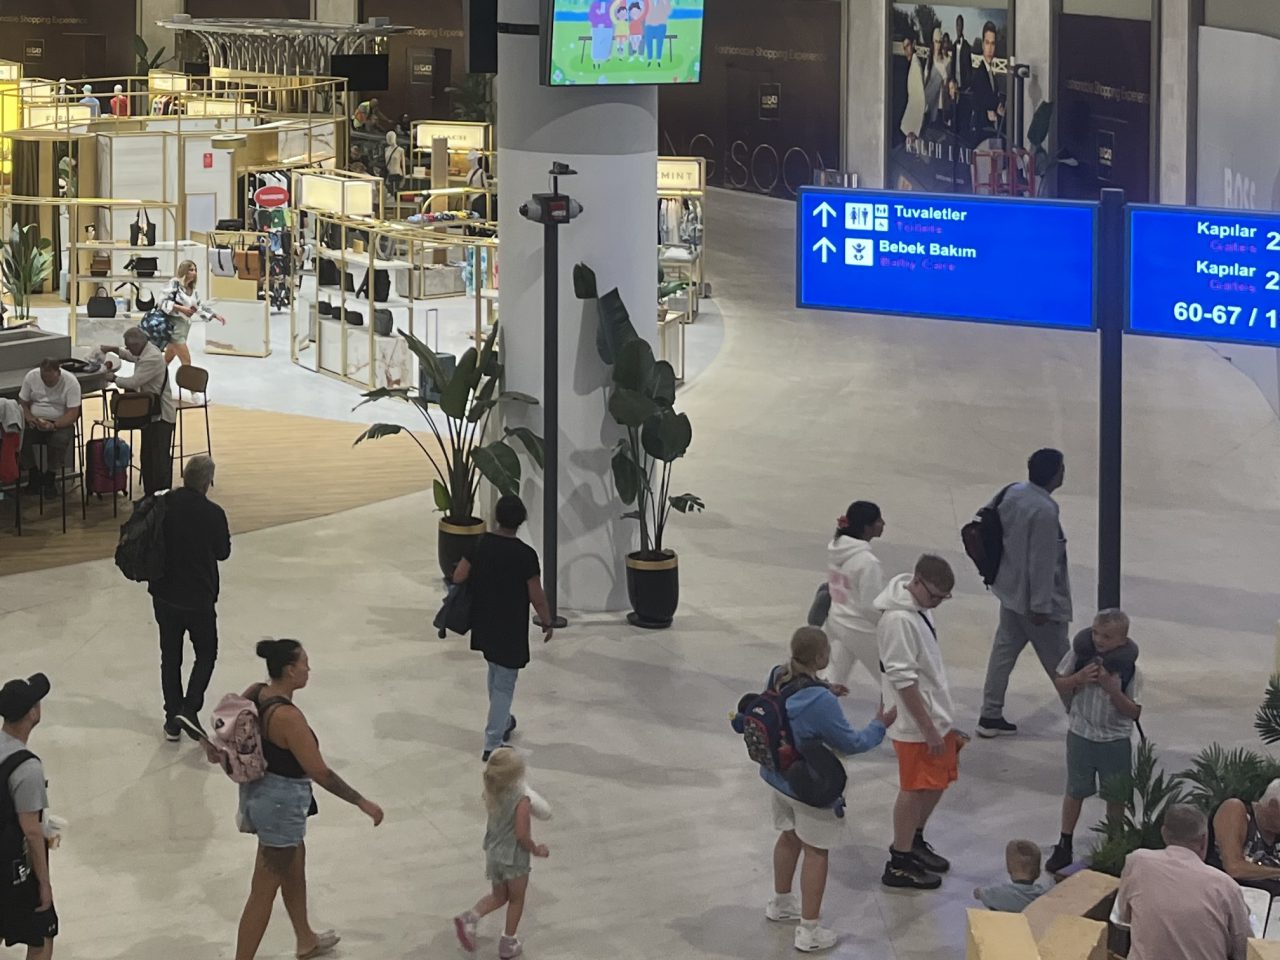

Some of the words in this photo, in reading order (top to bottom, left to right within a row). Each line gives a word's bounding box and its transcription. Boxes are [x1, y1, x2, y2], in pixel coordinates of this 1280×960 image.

[905, 136, 942, 159] RALPH
[948, 145, 972, 165] LAU
[894, 204, 968, 221] Tuvaletler
[1197, 221, 1257, 239] Kapılar
[879, 240, 926, 255] Bebek
[929, 243, 977, 258] Bakım
[1196, 260, 1257, 278] Kapılar
[1209, 279, 1257, 294] Gates
[1173, 301, 1242, 326] 60-67
[1248, 307, 1258, 327] /
